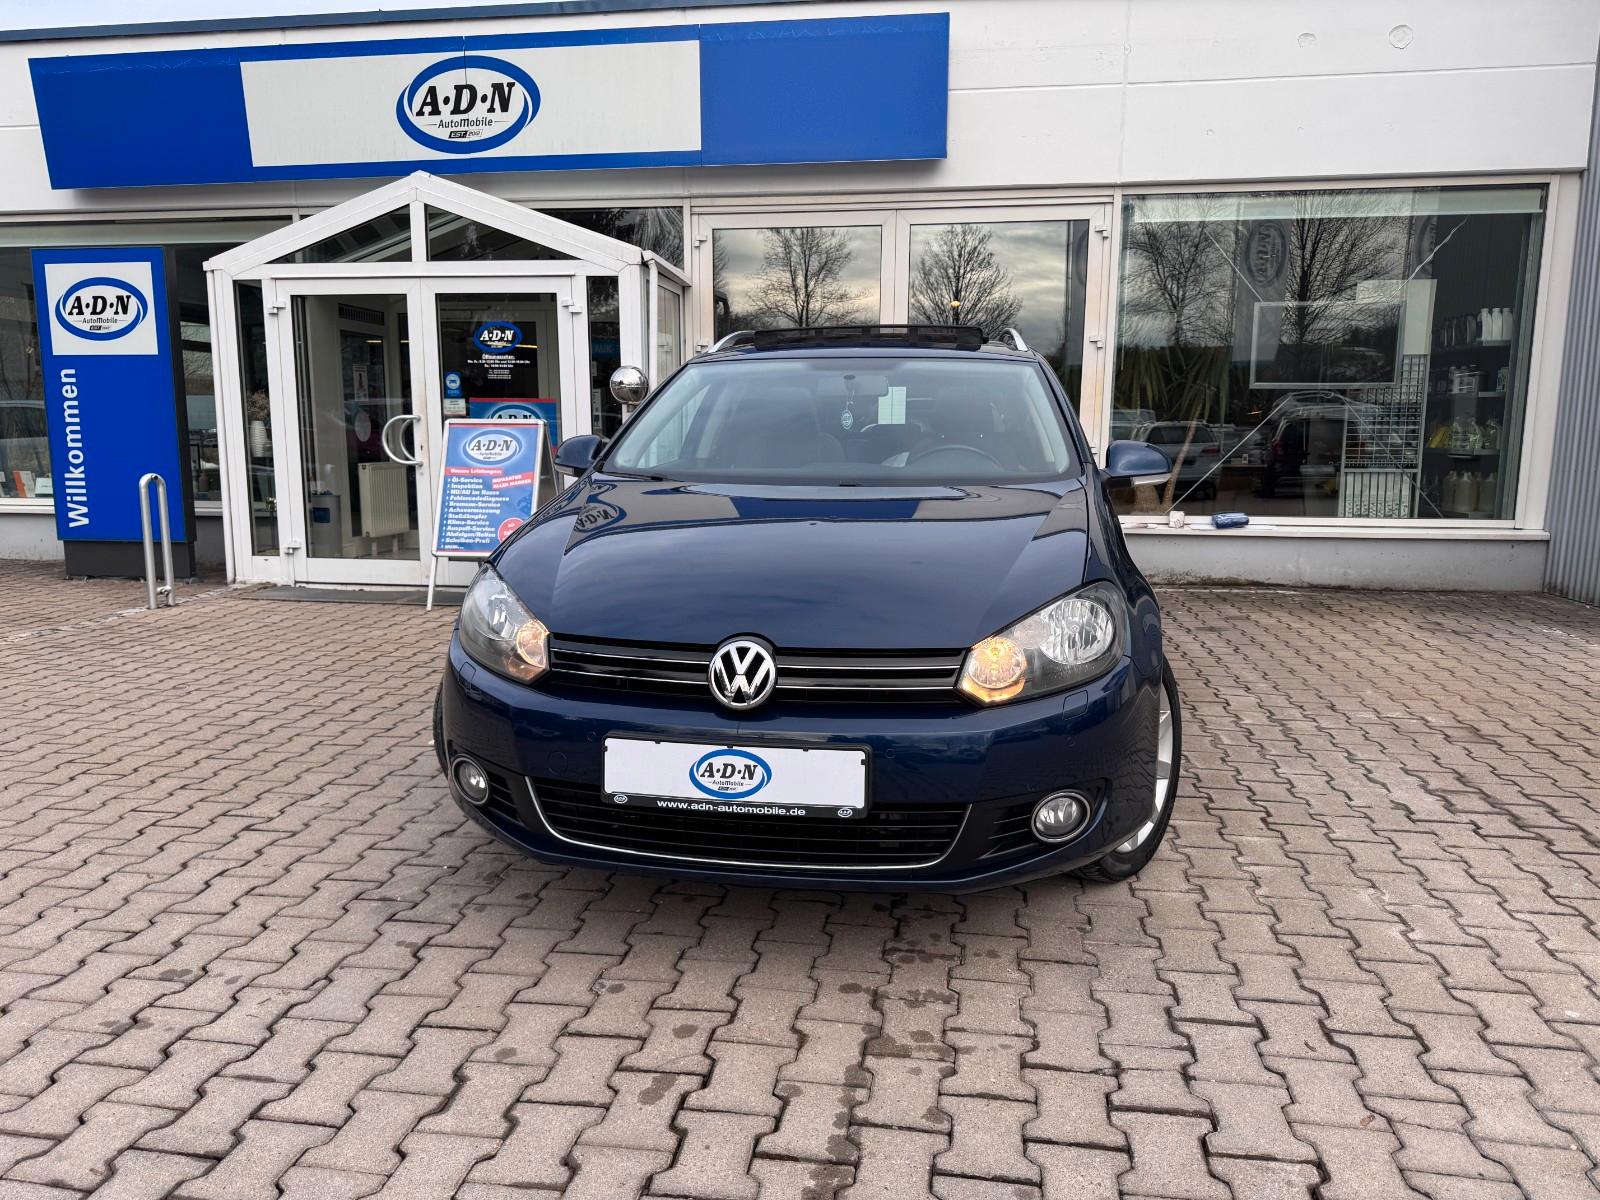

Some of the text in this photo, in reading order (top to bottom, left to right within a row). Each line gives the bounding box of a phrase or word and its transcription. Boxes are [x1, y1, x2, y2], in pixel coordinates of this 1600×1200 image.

[416, 82, 515, 116] A·D·N
[438, 117, 493, 128] AutoMobile
[68, 295, 131, 315] A·D·N
[60, 368, 90, 528] Willkommen
[700, 762, 758, 780] A·D·N
[657, 800, 806, 816] www.adn-automobile.de
